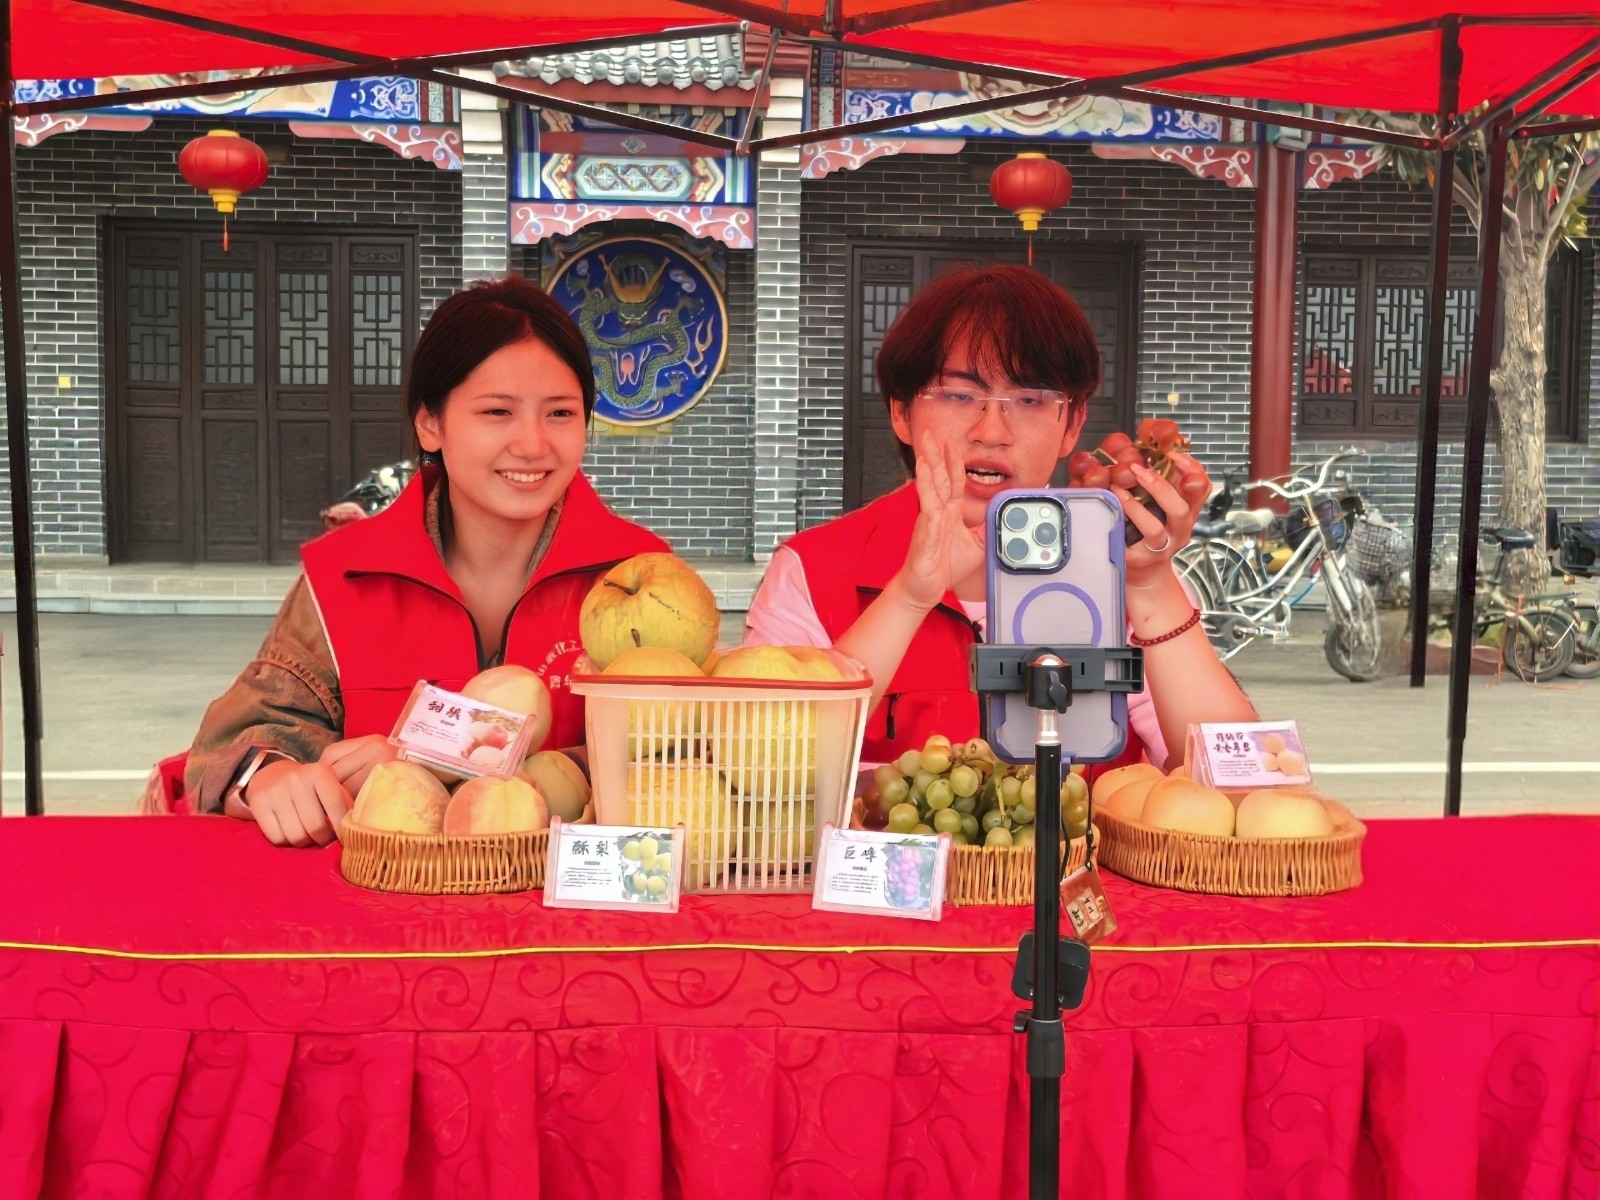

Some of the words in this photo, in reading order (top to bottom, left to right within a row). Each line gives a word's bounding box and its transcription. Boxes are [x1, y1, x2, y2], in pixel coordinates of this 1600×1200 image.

[428, 700, 462, 721] 甜桃
[571, 840, 610, 858] 酥梨
[844, 845, 877, 863] 巨峰
